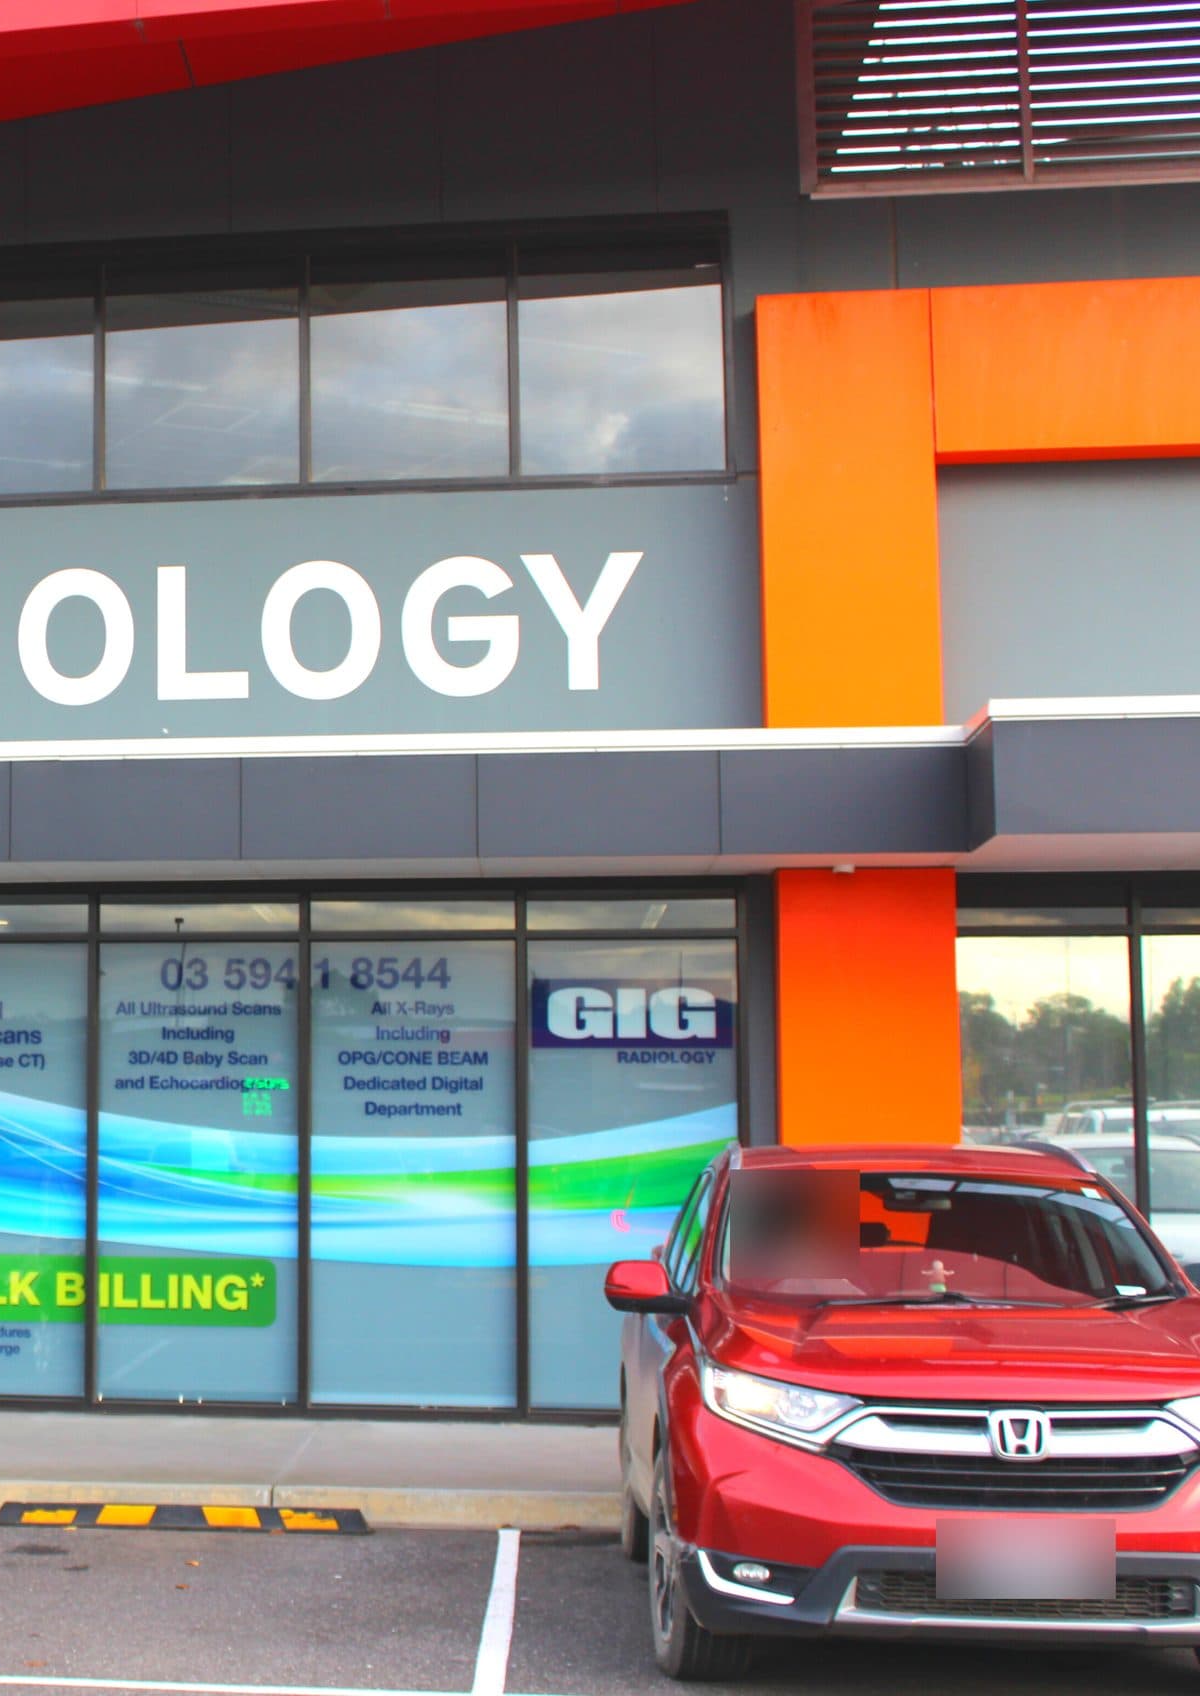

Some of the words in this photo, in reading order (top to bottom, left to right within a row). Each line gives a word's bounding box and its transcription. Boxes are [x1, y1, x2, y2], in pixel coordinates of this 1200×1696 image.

[160, 957, 209, 991] 03
[349, 956, 451, 990] 8544
[116, 1001, 135, 1016] All
[140, 1001, 227, 1016] Ultrasound
[231, 1001, 282, 1016] Scans
[371, 1001, 391, 1015] All
[397, 1001, 455, 1018] X-Rays
[547, 987, 717, 1039] GIG
[161, 1026, 235, 1043] Including
[376, 1026, 451, 1043] Including
[18, 1053, 46, 1071] CT)
[128, 1051, 179, 1066] 3D/4D
[183, 1050, 223, 1068] Baby
[227, 1050, 268, 1066] Scan
[338, 1051, 433, 1066] OPG/CONE
[437, 1051, 489, 1065] BEAM
[617, 1050, 716, 1064] RADIOLOGY
[115, 1076, 145, 1090] and
[343, 1076, 427, 1091] Dedicated
[431, 1076, 484, 1093] Digital
[364, 1101, 463, 1118] Department
